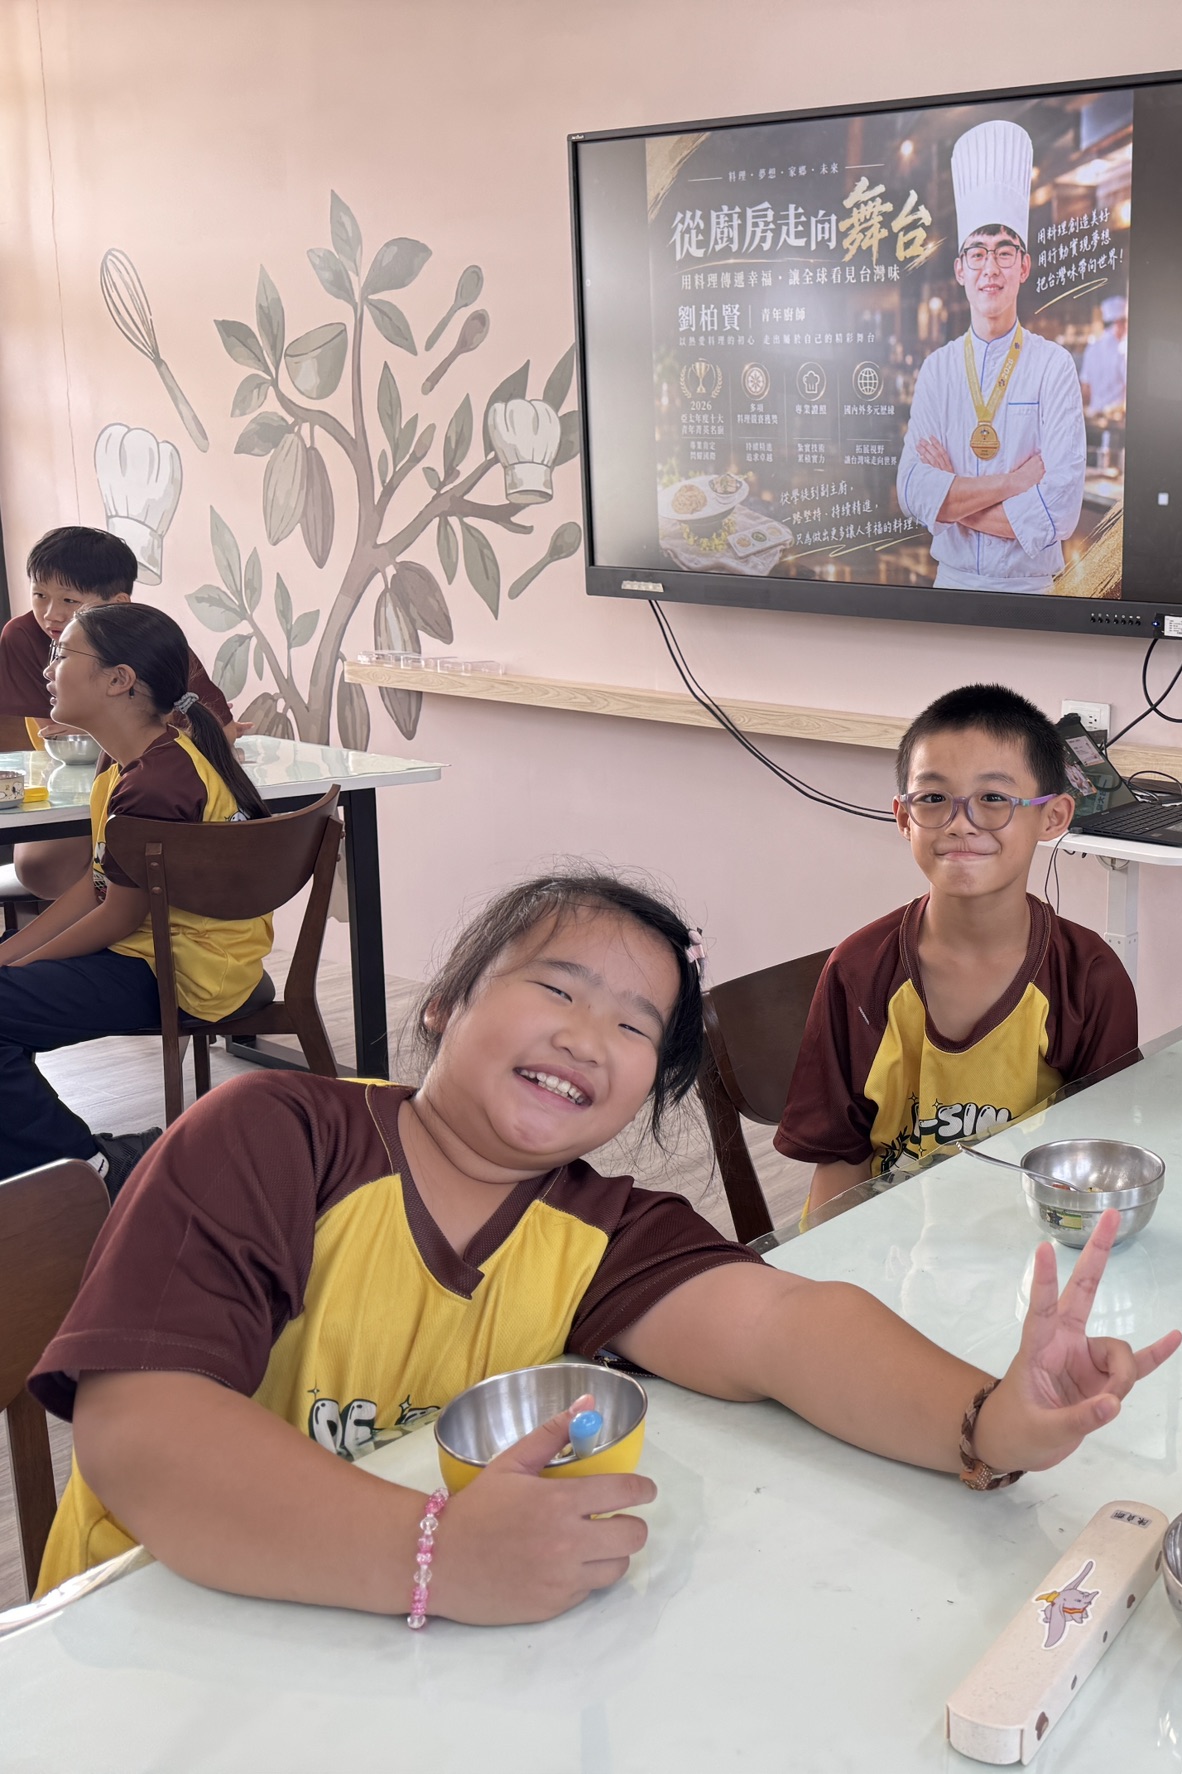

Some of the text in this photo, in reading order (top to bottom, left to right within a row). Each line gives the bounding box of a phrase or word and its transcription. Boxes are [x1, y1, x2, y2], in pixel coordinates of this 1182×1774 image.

[666, 176, 933, 264] 從廚房走向舞台
[1037, 208, 1110, 245] 用料理創造美好
[1038, 228, 1111, 268] 用行動實現夢想
[678, 304, 807, 332] 劉柏賢 青年廚師
[690, 401, 713, 411] 2026
